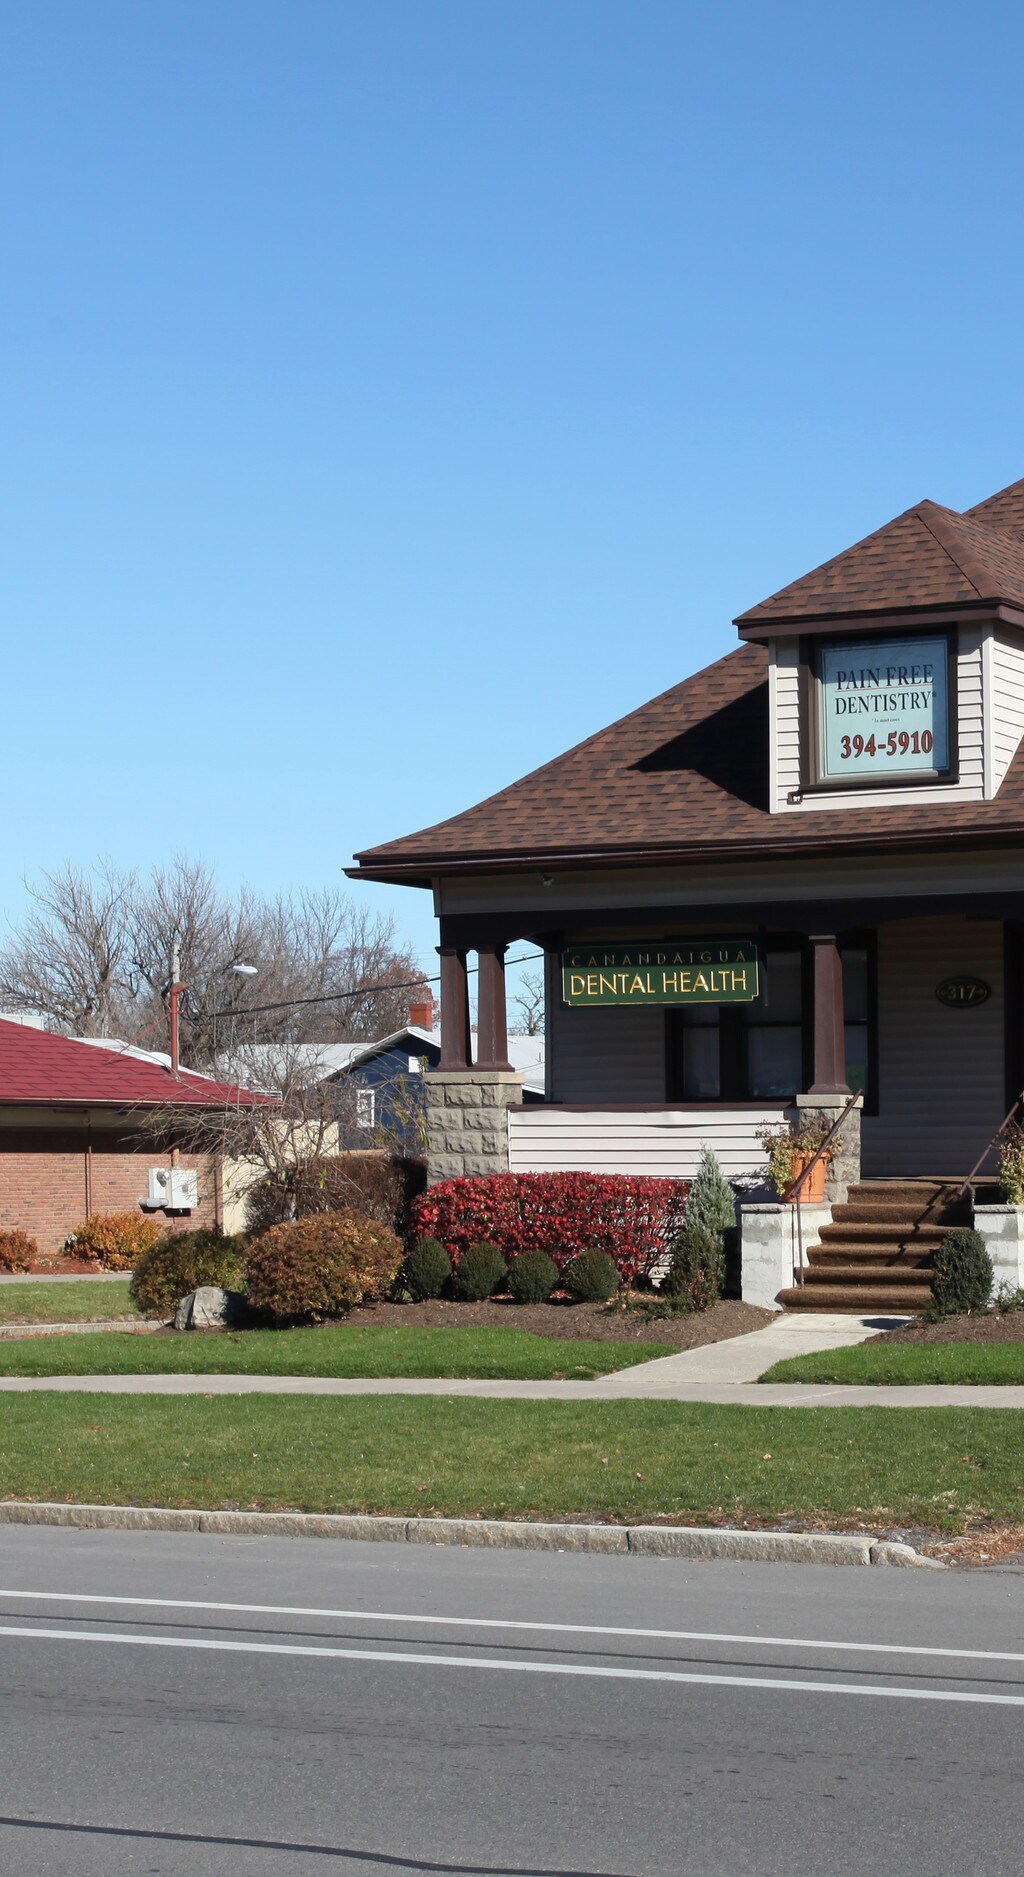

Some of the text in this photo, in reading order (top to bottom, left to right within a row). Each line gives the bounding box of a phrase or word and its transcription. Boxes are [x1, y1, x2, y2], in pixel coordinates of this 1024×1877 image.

[836, 664, 934, 690] PAIN FREE
[840, 730, 933, 759] 394-5910
[571, 950, 746, 967] CANANDAIGUA
[570, 970, 747, 996] DENTAL HEALTH
[947, 984, 977, 1000] 317
